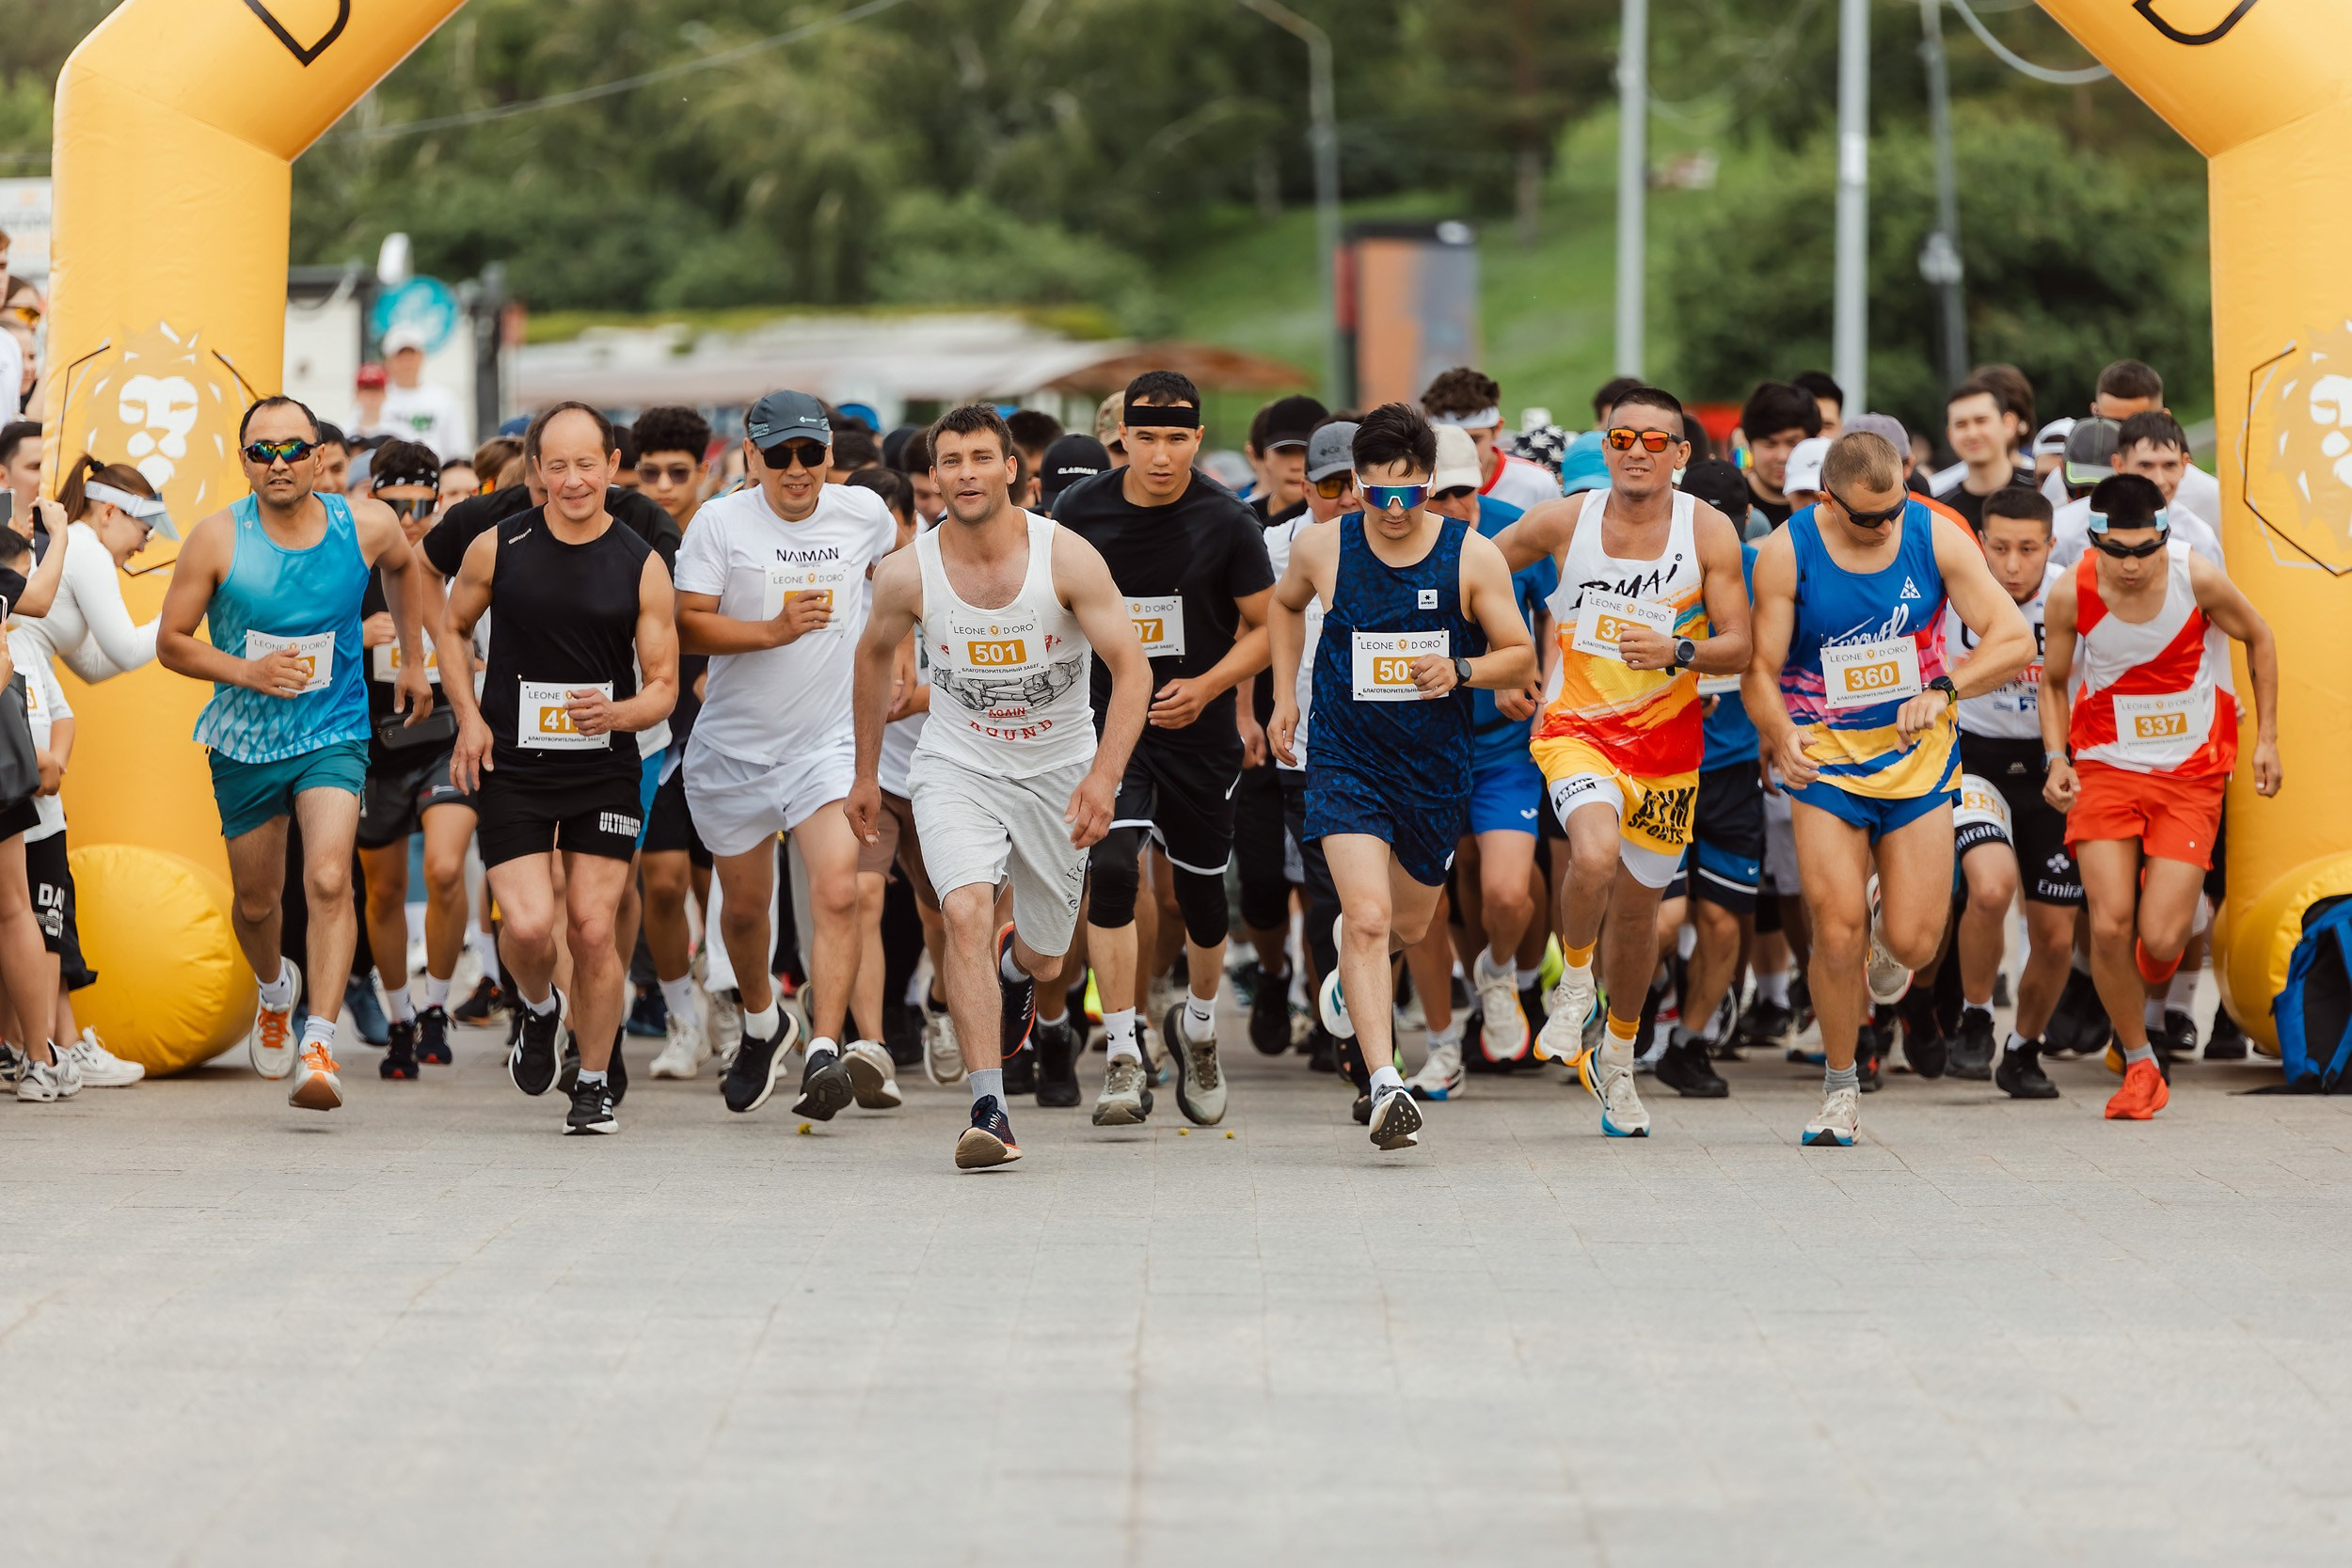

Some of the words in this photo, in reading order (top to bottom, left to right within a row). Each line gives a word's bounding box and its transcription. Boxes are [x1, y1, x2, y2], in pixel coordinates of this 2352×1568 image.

[776, 547, 839, 562] NAIMAN
[772, 576, 803, 584] LEONE
[1590, 597, 1623, 612] LEONE
[953, 626, 986, 636] LEONE
[1003, 624, 1034, 635] D'ORO
[975, 642, 1018, 663] 501
[1360, 641, 1394, 650] LEONE
[1411, 640, 1441, 650] D'ORO
[1830, 653, 1862, 663] LEONE
[1879, 645, 1908, 657] D'ORO
[1379, 660, 1417, 682] 50
[1851, 665, 1894, 689] 360
[528, 691, 561, 701] LEONE
[544, 709, 579, 731] 41
[2140, 715, 2181, 736] 337
[1639, 786, 1696, 828] GYM
[1628, 812, 1684, 845] SPORTS
[38, 882, 65, 911] DA
